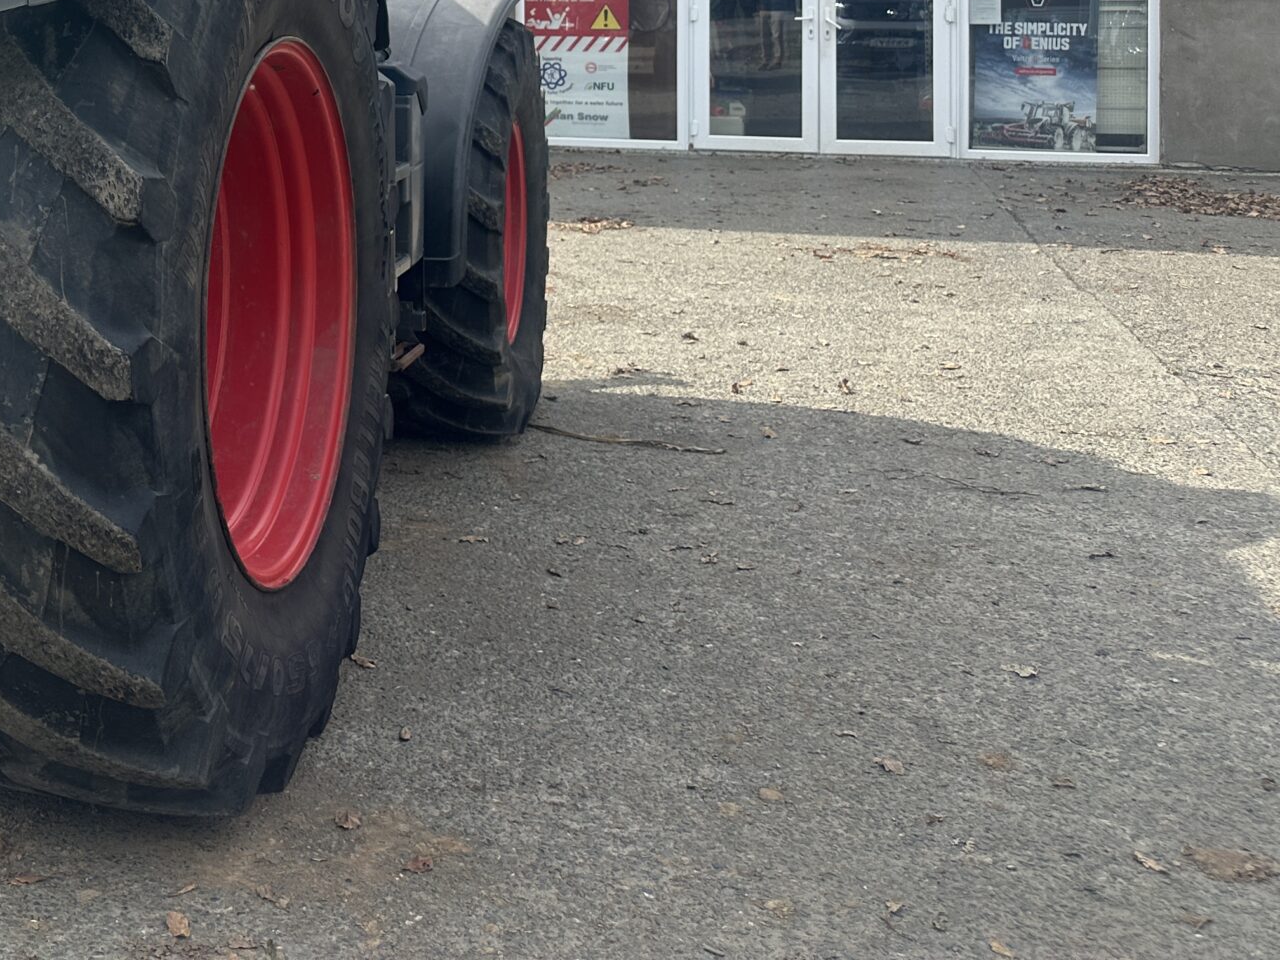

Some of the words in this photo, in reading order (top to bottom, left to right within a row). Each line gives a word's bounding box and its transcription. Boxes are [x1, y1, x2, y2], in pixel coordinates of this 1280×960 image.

[988, 22, 1012, 34] THE
[1014, 21, 1087, 36] SIMPLICITY
[1003, 36, 1021, 49] OF
[593, 82, 615, 91] NFU
[577, 112, 609, 121] Snow
